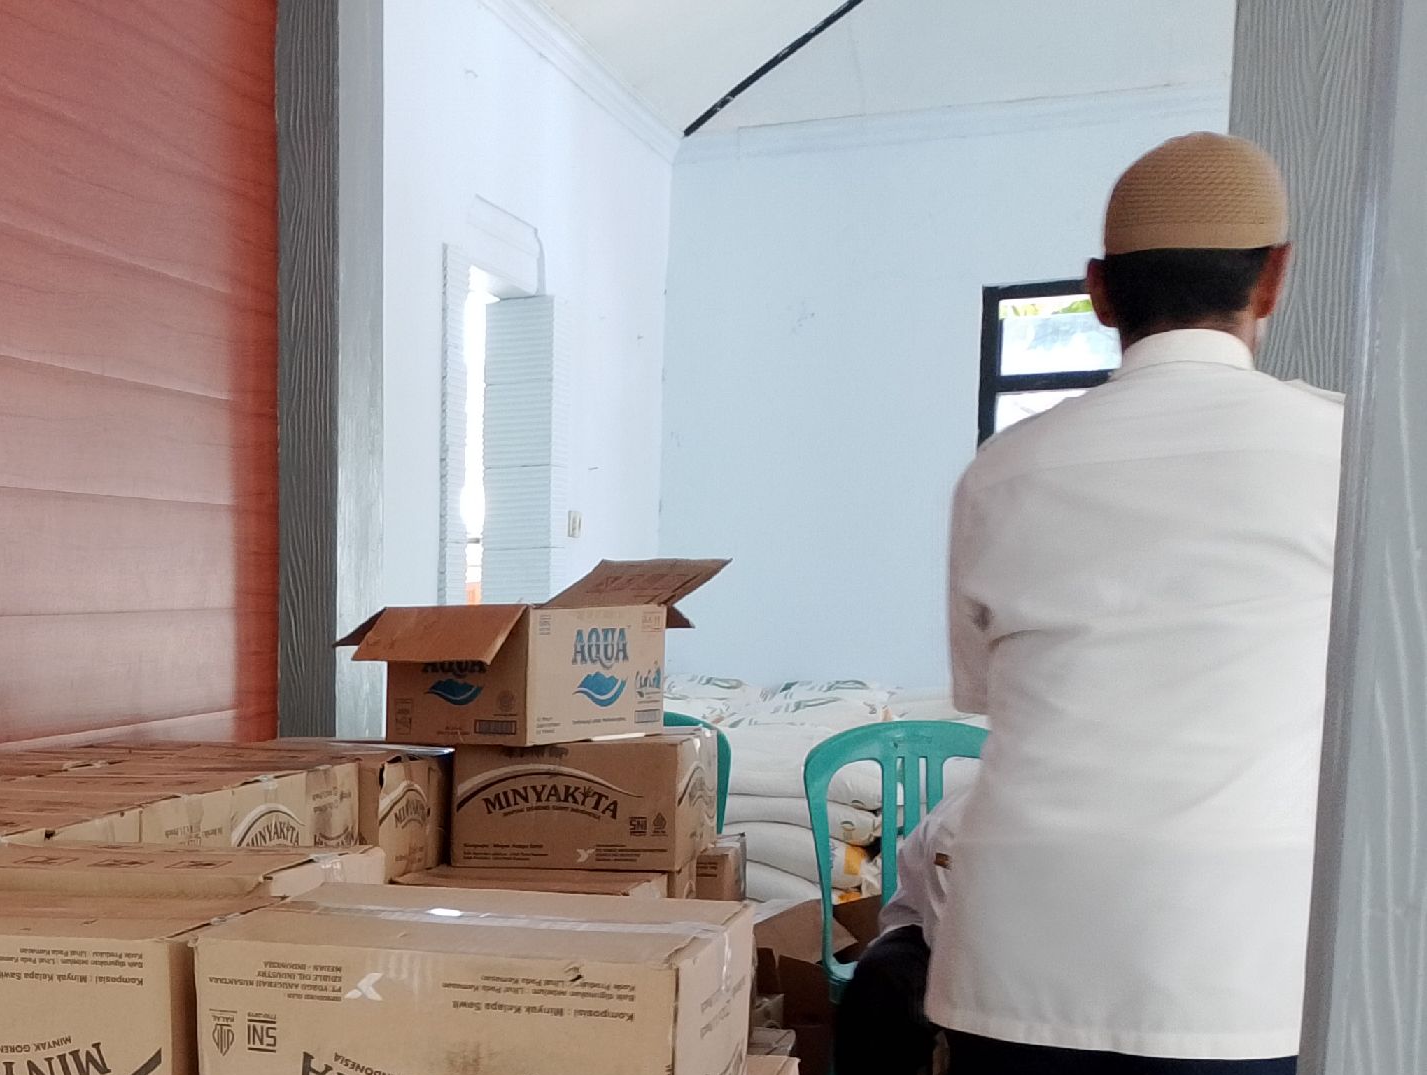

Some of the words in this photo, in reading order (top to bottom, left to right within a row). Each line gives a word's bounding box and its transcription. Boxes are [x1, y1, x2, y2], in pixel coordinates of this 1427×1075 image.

[572, 627, 629, 670] AQUA
[34, 1035, 71, 1052] MINYAK
[247, 1024, 277, 1047] SNI
